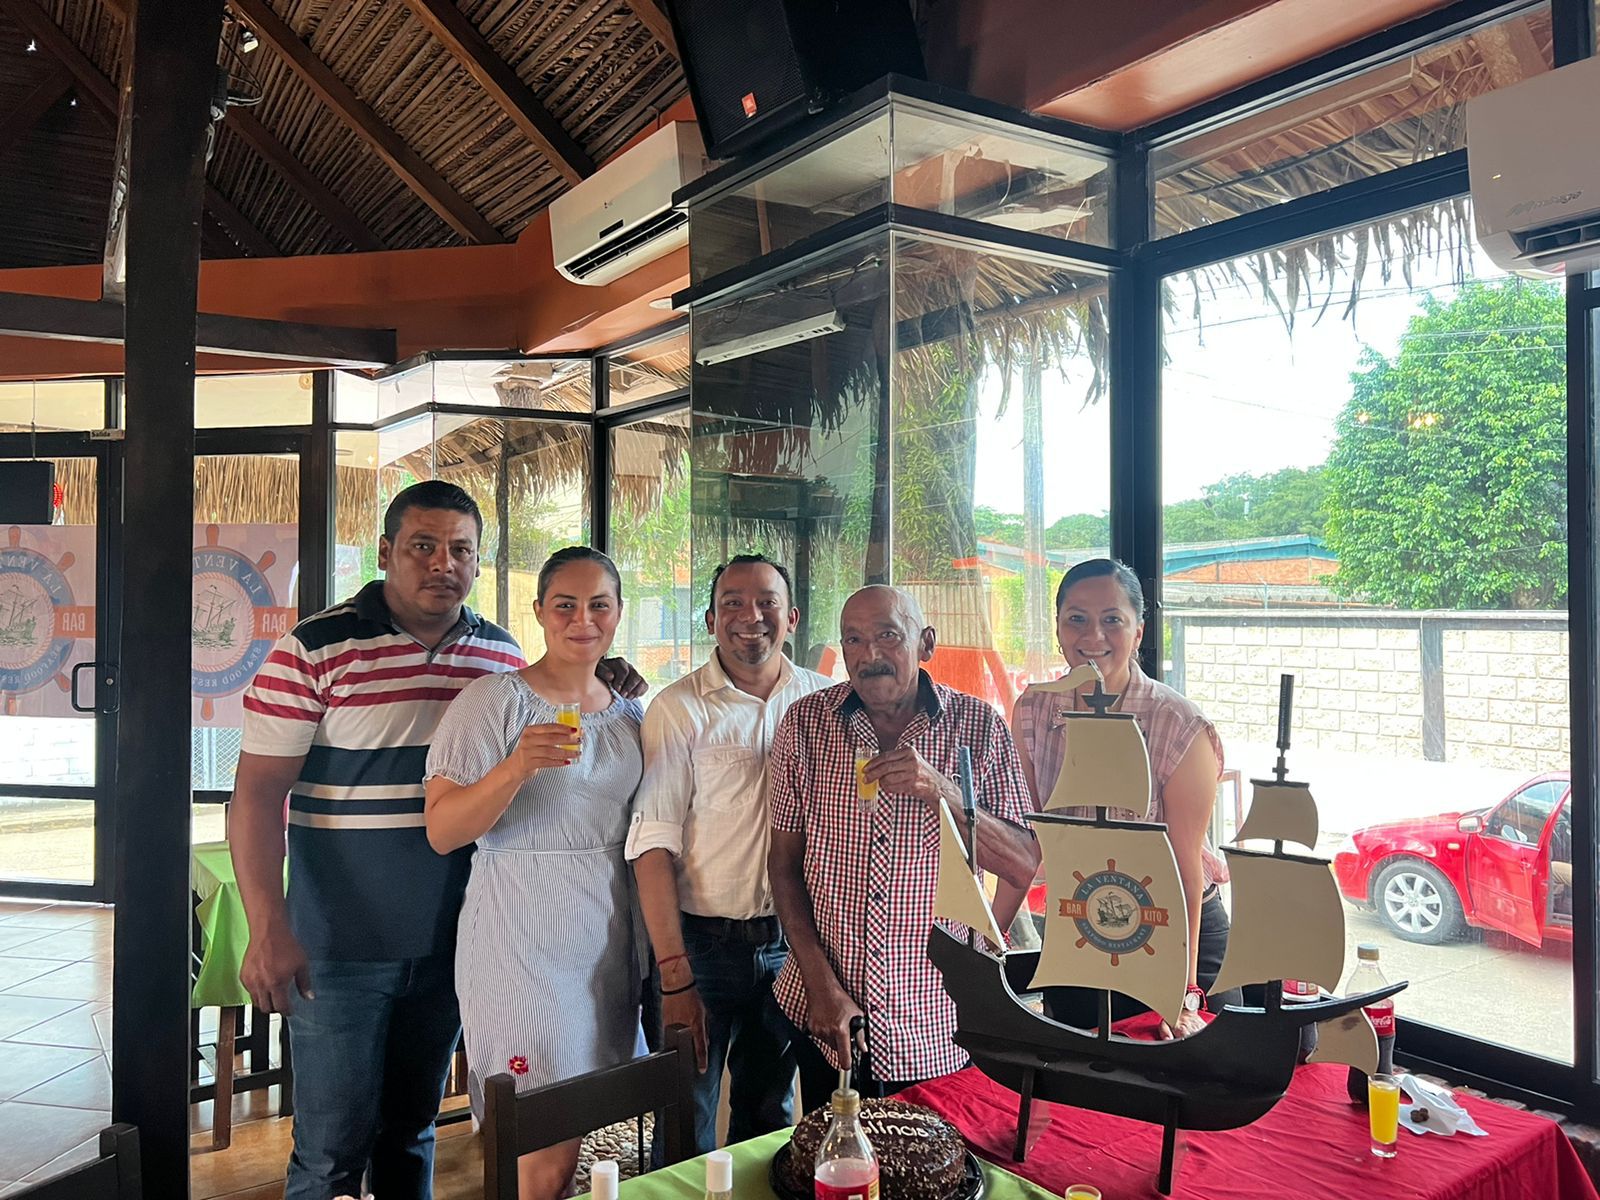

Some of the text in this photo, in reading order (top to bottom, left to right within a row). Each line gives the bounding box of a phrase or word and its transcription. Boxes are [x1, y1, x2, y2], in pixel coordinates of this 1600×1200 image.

[1081, 875, 1144, 900] LA VENTANA
[1066, 903, 1082, 915] BAR
[1144, 910, 1162, 922] KITO
